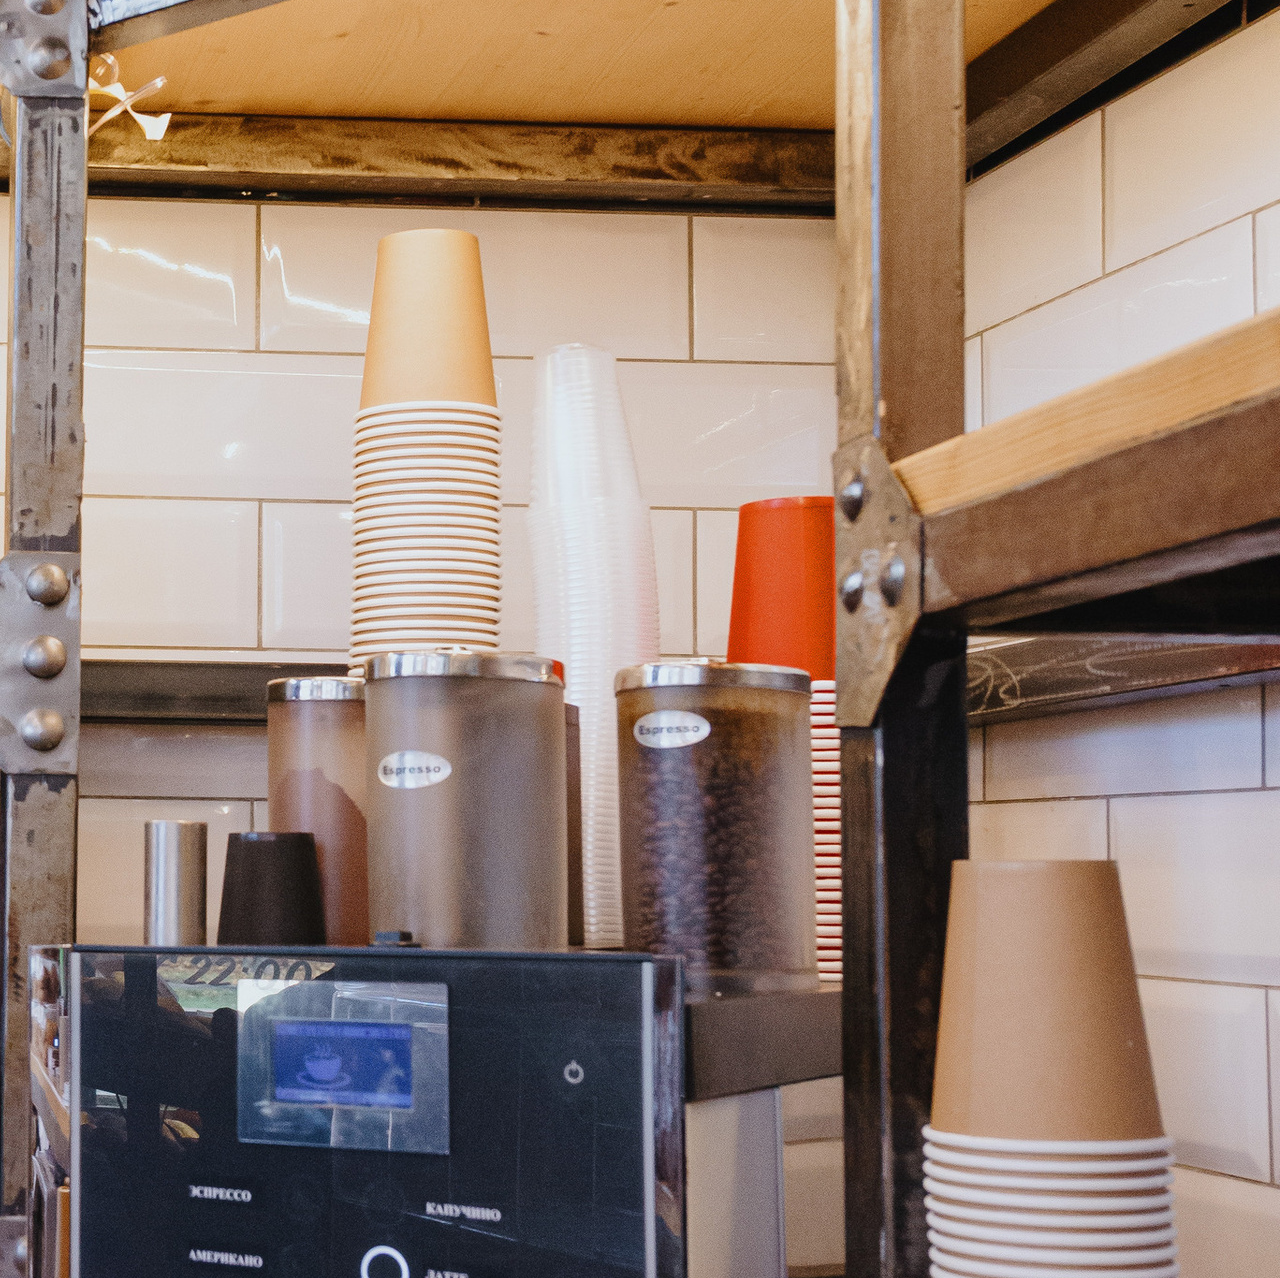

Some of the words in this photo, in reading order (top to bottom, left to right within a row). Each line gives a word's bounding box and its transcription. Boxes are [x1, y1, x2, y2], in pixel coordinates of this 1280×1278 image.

[638, 724, 700, 737] Espresso
[383, 763, 441, 777] Espresso
[189, 1184, 252, 1203] ЭСПРЕССО
[425, 1201, 502, 1222] КАПУЧИНО
[189, 1248, 263, 1269] АМЕРИКАНО
